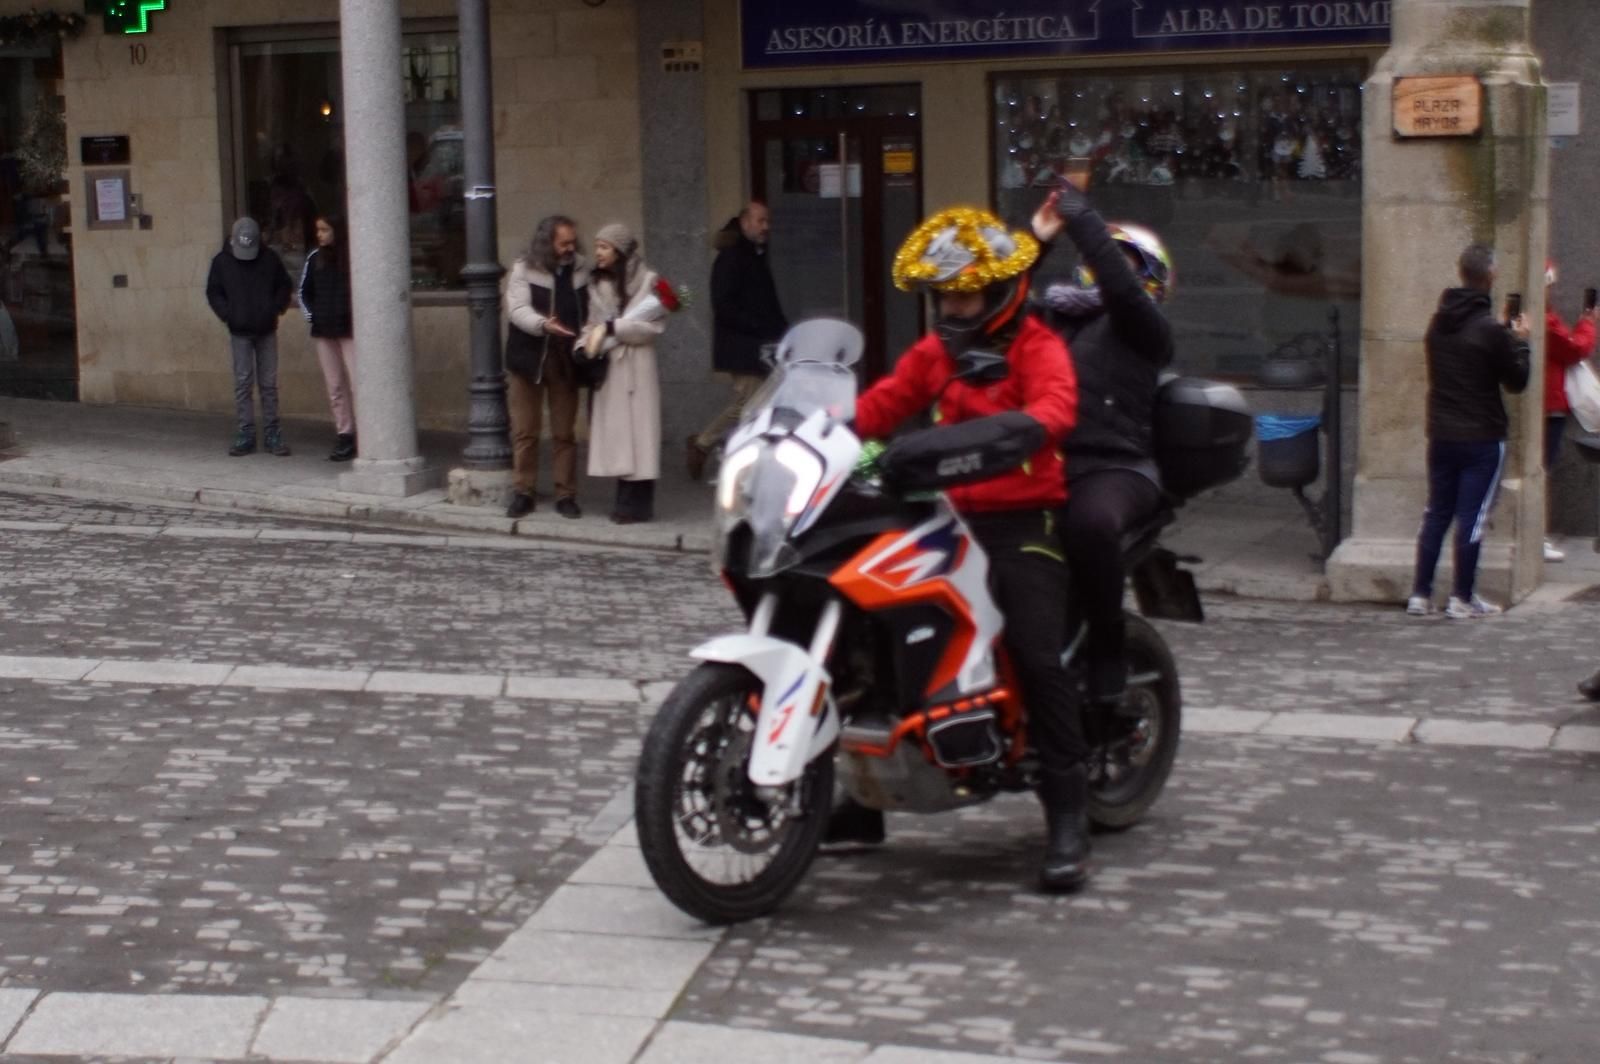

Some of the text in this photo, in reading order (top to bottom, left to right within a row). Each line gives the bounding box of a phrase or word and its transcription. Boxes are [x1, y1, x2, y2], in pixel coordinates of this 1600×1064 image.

[1159, 8, 1236, 33] ALBA
[1245, 5, 1281, 30] DE
[767, 12, 1076, 50] ASESORÍA ENERGÉTICA
[129, 44, 147, 65] 10
[1413, 99, 1460, 113] PLAZA
[1413, 116, 1460, 129] MAYOR
